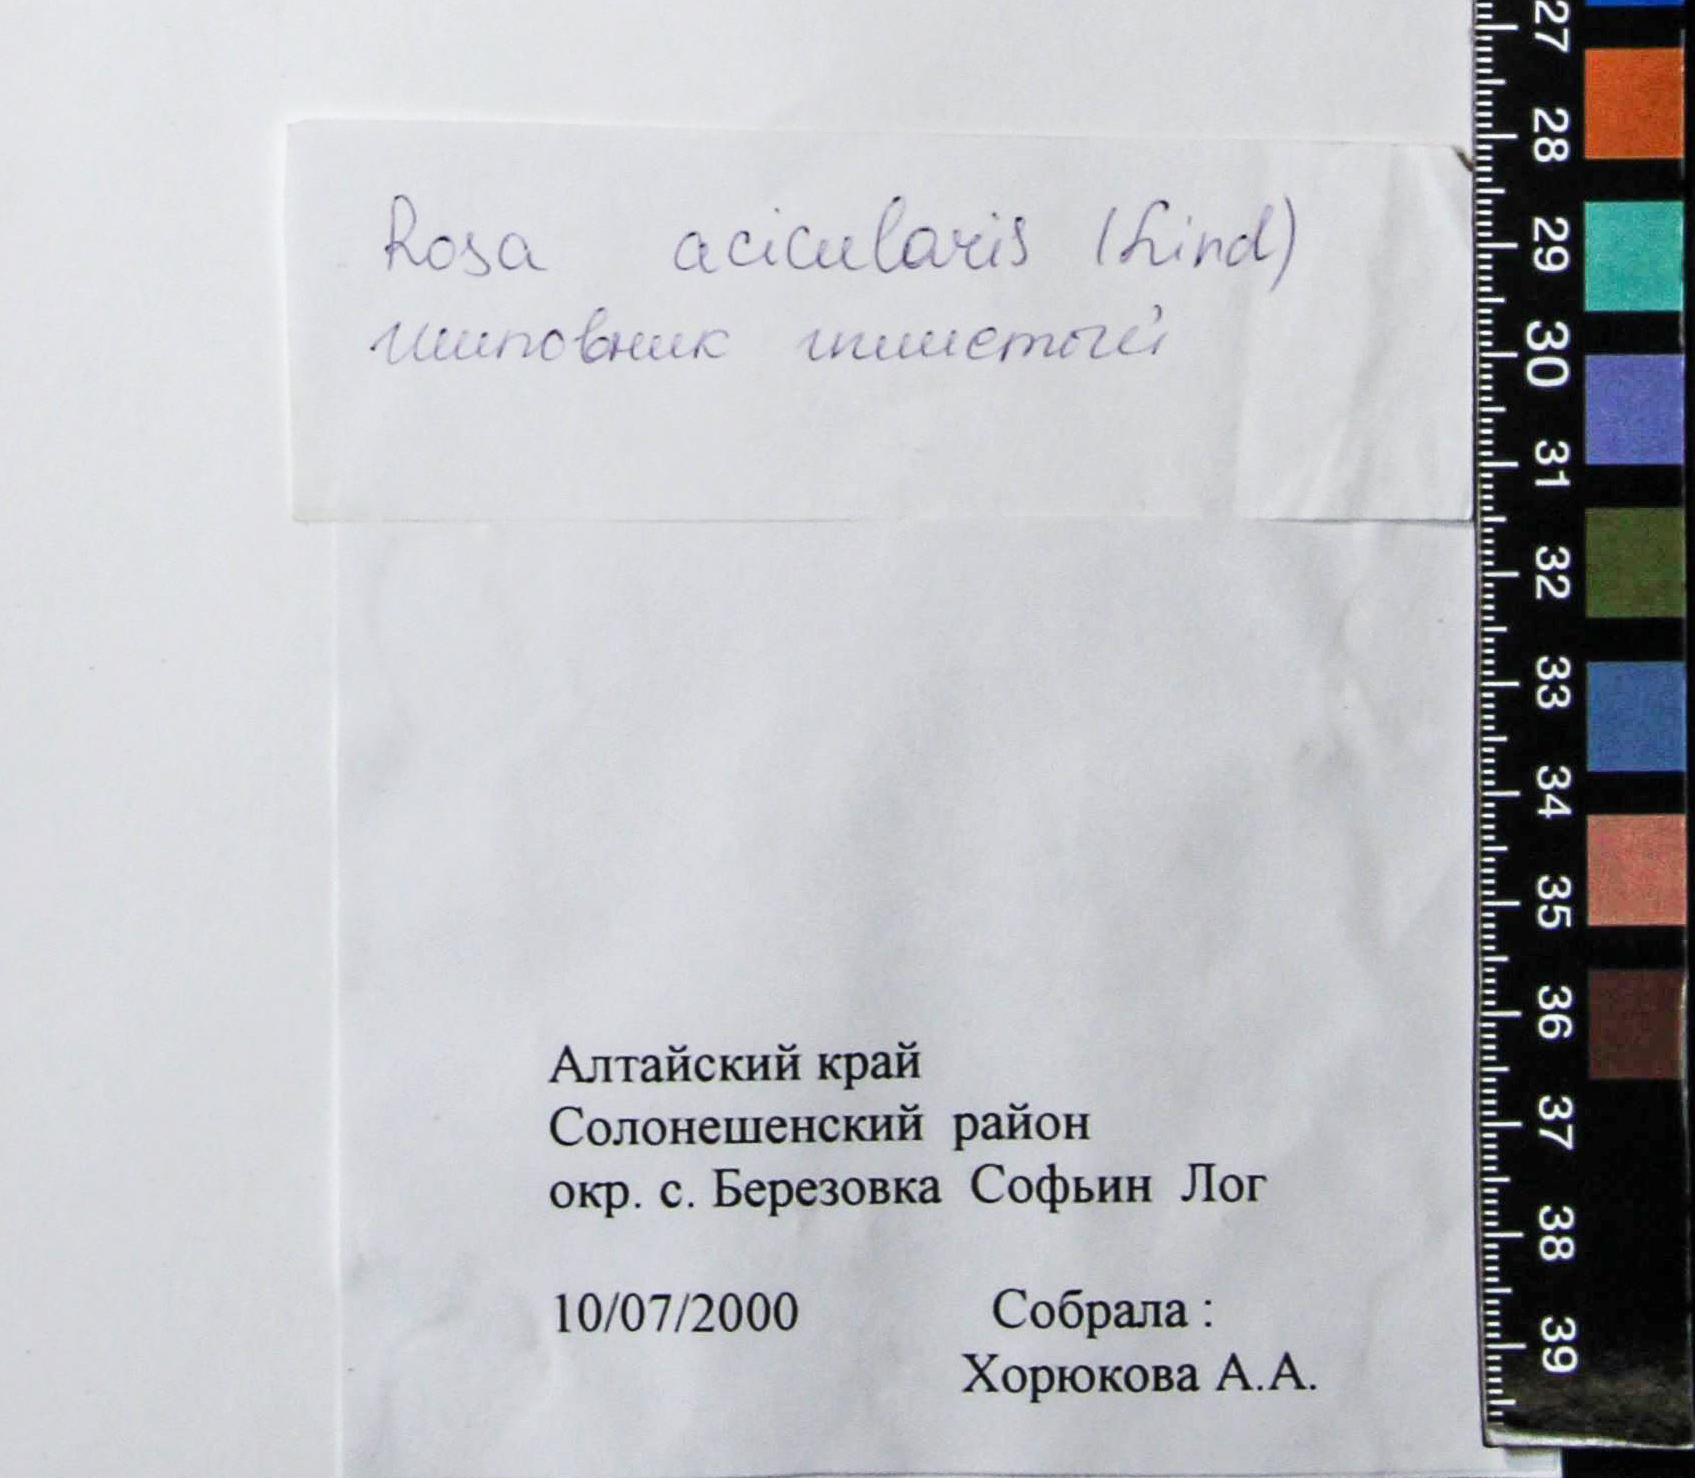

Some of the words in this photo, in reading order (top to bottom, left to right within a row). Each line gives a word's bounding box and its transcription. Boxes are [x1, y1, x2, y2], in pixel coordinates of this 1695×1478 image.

[1534, 0, 1570, 53] 27
[1533, 107, 1570, 163] 28
[384, 193, 548, 277] Rosa
[673, 195, 1029, 275] acicularis
[1533, 216, 1570, 272] 29
[1526, 320, 1570, 388] 30
[1534, 440, 1571, 487] 31
[1535, 545, 1571, 600] 32
[1536, 656, 1572, 709] 33
[1536, 765, 1572, 819] 34
[1537, 875, 1572, 929] 35
[1537, 985, 1573, 1039] 36
[548, 1043, 802, 1084] Алтайский
[817, 1040, 921, 1088] край
[549, 1103, 924, 1147] Солонешенский
[952, 1102, 1091, 1152] район
[1538, 1095, 1574, 1150] 37
[549, 1180, 642, 1216] окр.
[659, 1179, 695, 1209] с.
[712, 1167, 943, 1217] Березовка
[970, 1162, 1153, 1214] Софьин
[1180, 1162, 1269, 1204] Лог
[1538, 1205, 1575, 1261] 38
[554, 1290, 800, 1334] 10/07/2000
[992, 1287, 1190, 1339] Собрала
[1541, 1316, 1578, 1373] 39
[960, 1352, 1201, 1404] Хорюкова
[1214, 1350, 1318, 1392] А.А.
